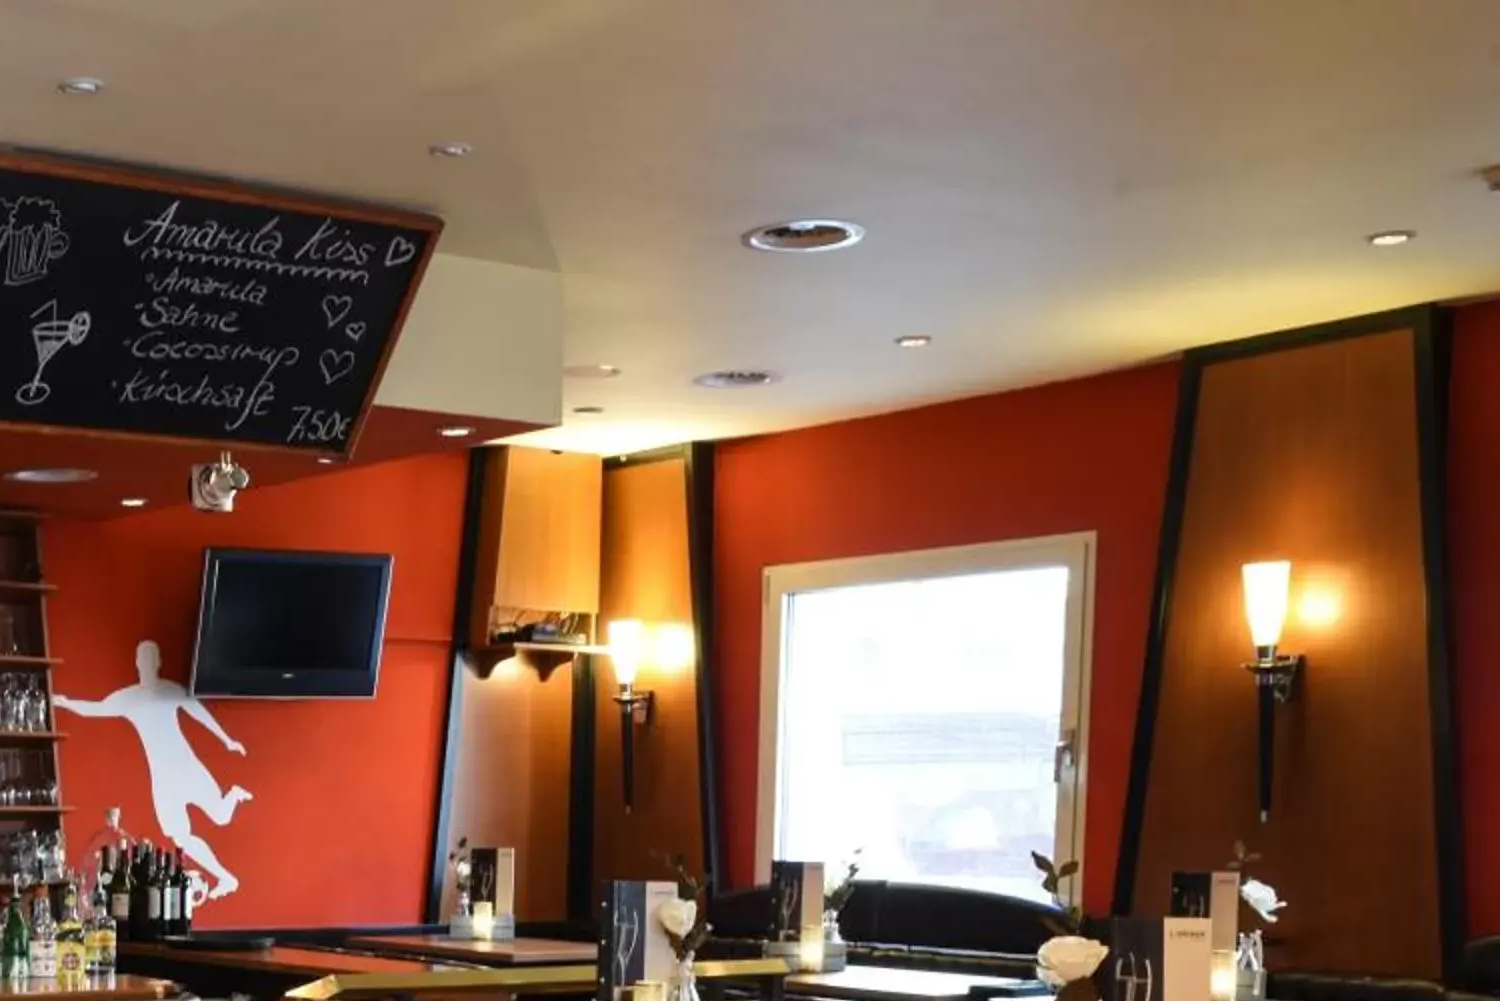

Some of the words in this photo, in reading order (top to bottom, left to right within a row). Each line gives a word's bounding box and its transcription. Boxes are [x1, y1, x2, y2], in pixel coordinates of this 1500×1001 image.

[123, 200, 284, 259] Amarula
[294, 216, 377, 267] Kiss
[152, 266, 268, 306] Amarula
[140, 296, 241, 332] Sahne
[119, 369, 276, 431] Kirschsaft
